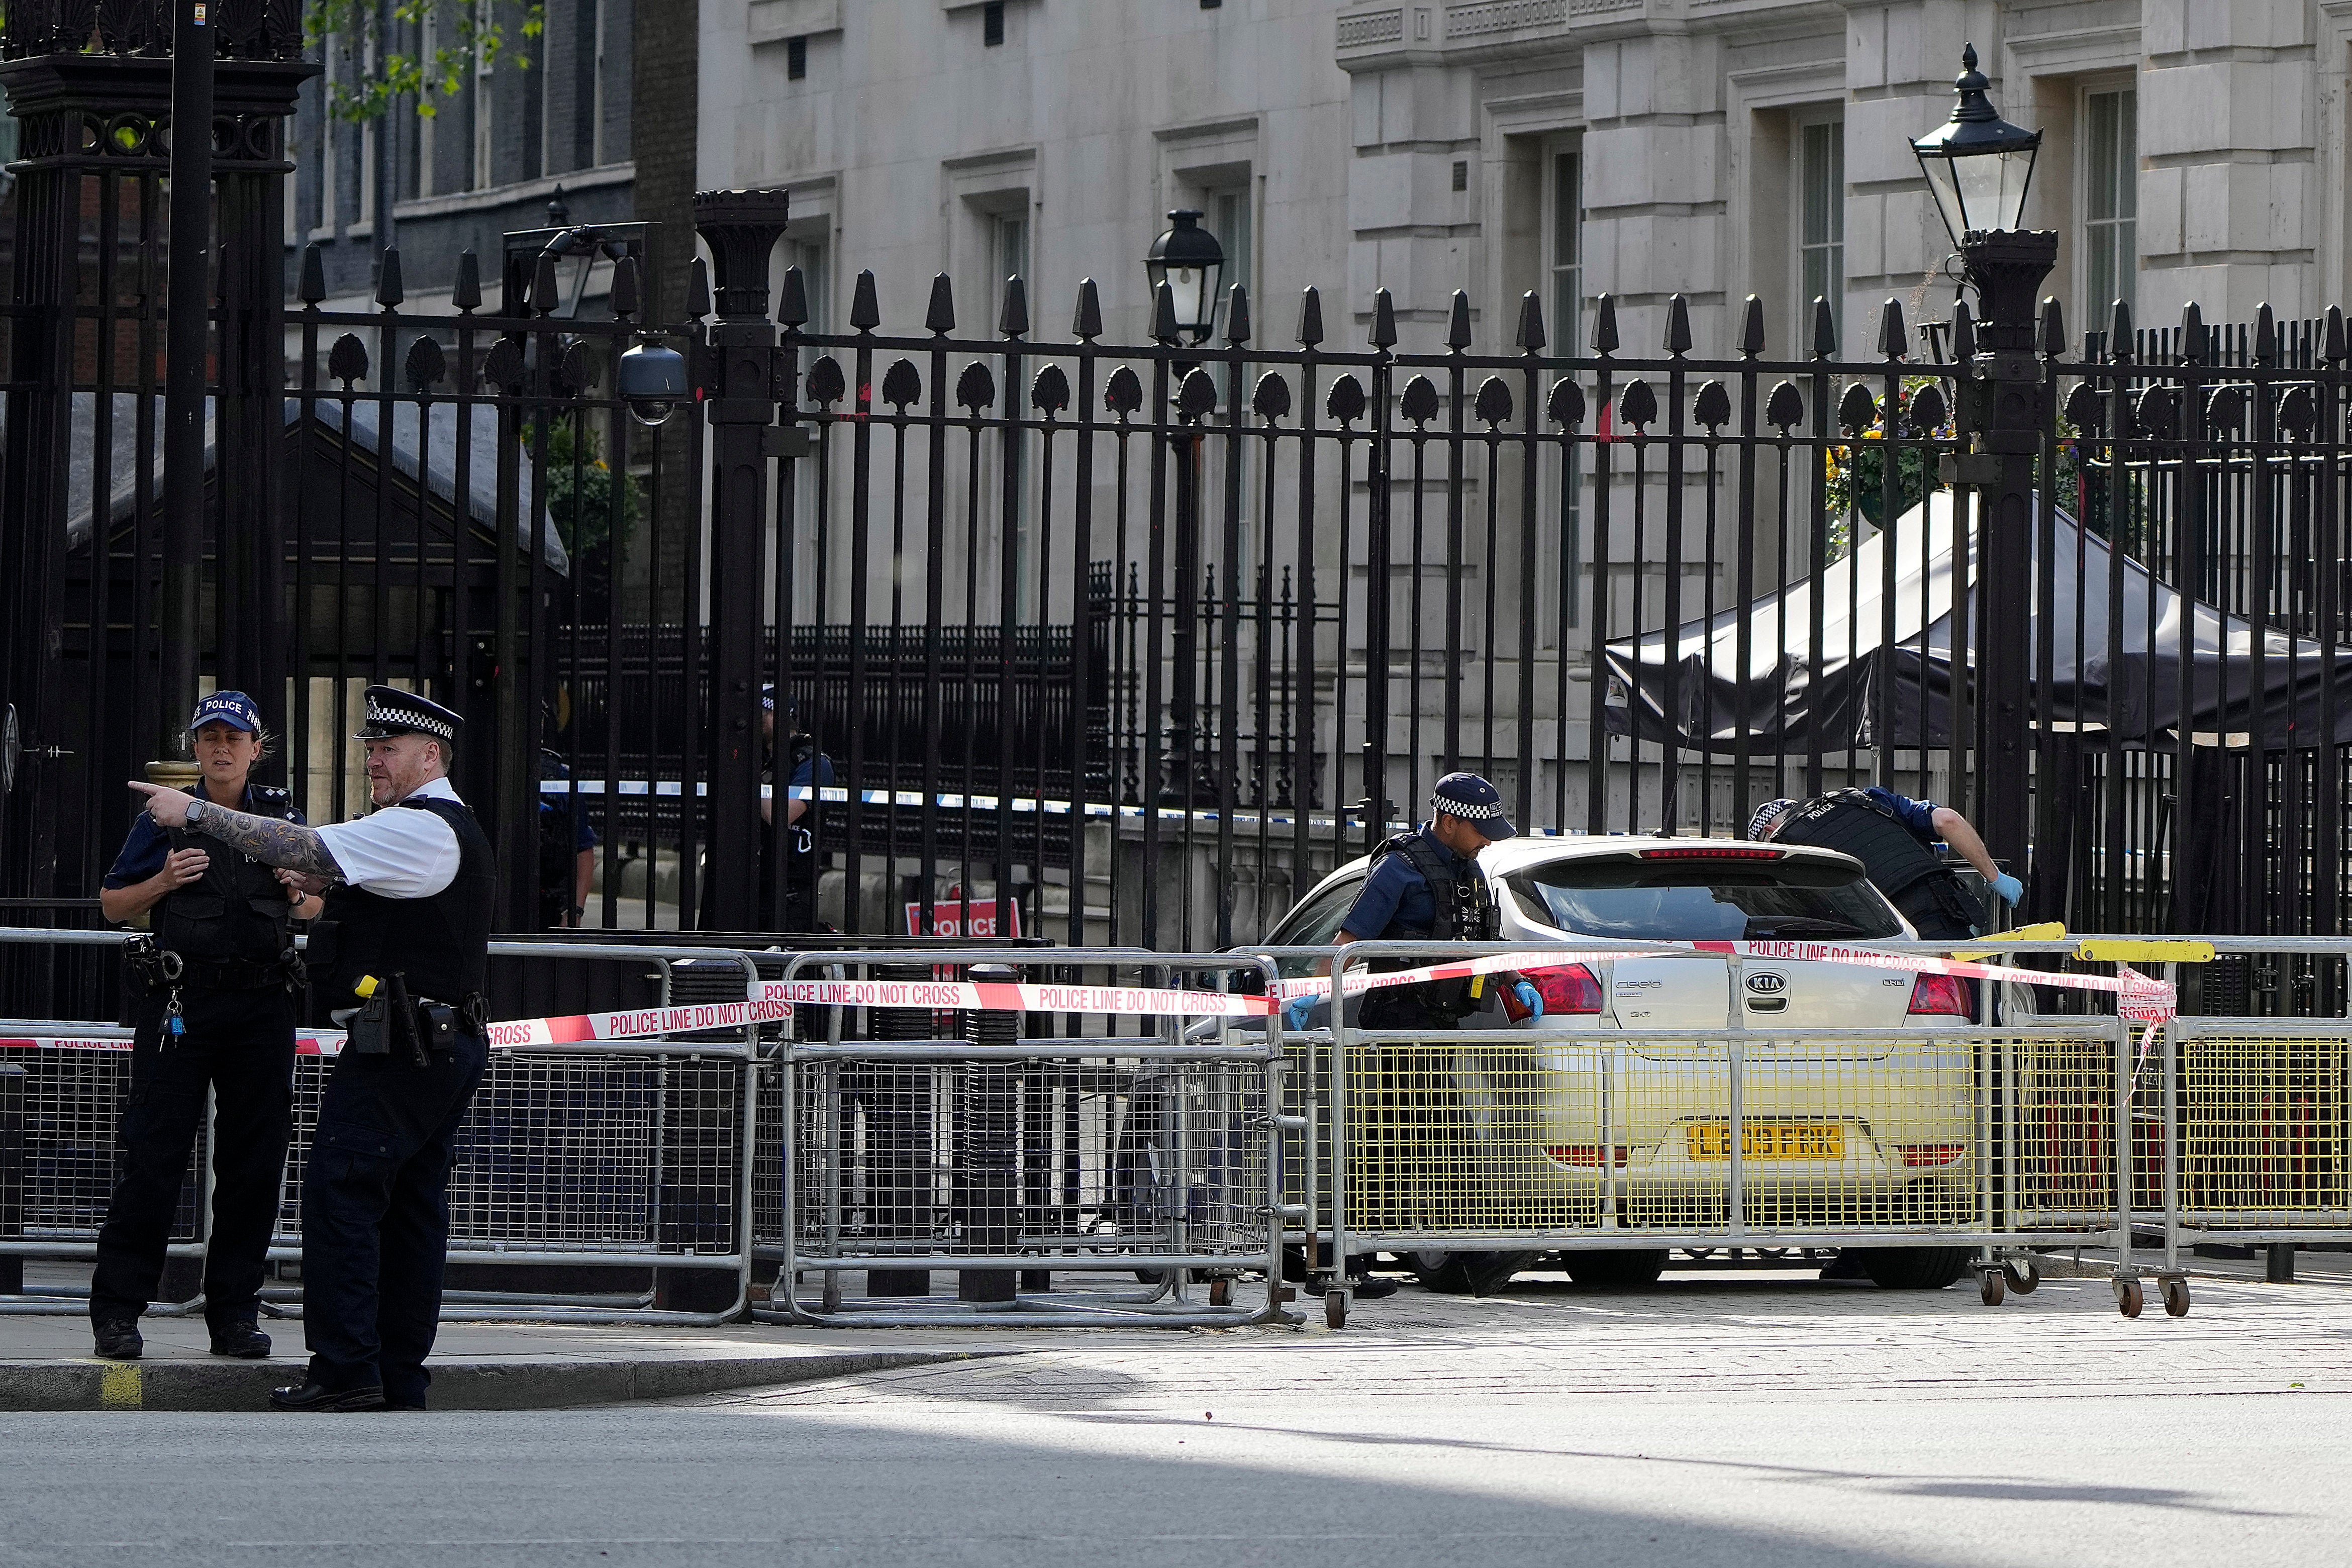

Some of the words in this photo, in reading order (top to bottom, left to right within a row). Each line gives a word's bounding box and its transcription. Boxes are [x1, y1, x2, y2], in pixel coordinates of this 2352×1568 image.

[205, 700, 242, 714] POLICE
[1807, 803, 1835, 820] POLICE
[1749, 940, 1795, 958] POLICE
[1799, 943, 1828, 960] LINE
[1753, 977, 1781, 989] KIA
[765, 985, 815, 1002] POLICE
[820, 985, 851, 1003] LINE
[856, 985, 875, 1003] DO
[879, 985, 908, 1004] NOT
[913, 986, 960, 1005] CROSS
[1040, 989, 1088, 1009] POLICE
[1093, 990, 1122, 1010] LINE
[1127, 991, 1145, 1011] DO
[1150, 992, 1178, 1011] NOT
[1182, 993, 1227, 1012] CROSS
[610, 1013, 658, 1035] POLICE
[662, 1009, 692, 1031] LINE
[696, 1007, 714, 1027] DO
[718, 1003, 744, 1024] NOT
[748, 1000, 793, 1021] CROSS
[488, 1024, 531, 1045] CROSS
[2141, 1067, 2164, 1086] CLEAR
[1781, 1128, 1833, 1154] FRK
